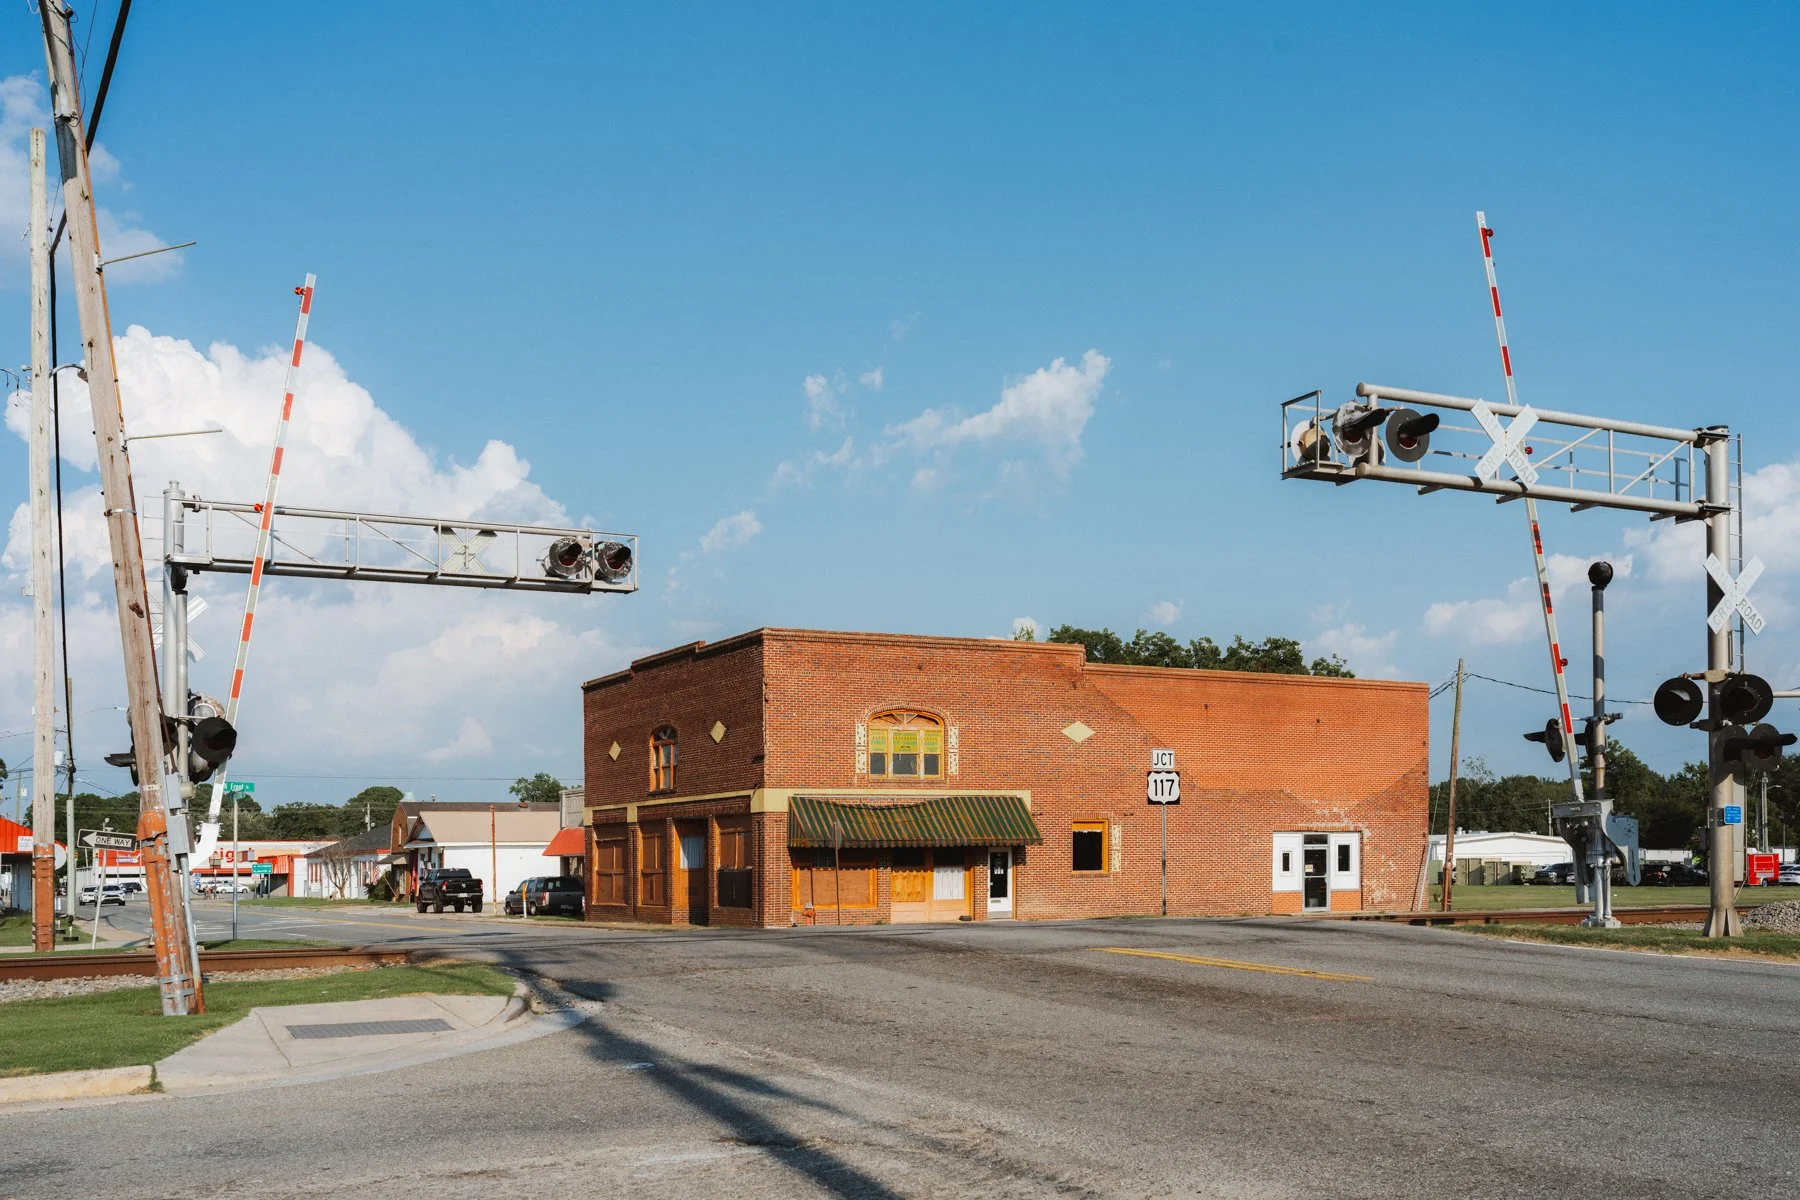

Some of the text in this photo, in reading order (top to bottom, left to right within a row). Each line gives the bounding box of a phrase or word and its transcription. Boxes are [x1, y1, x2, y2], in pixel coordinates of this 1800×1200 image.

[1508, 449, 1534, 483] ROAD
[1738, 598, 1762, 630] ROAD
[1153, 752, 1174, 766] JCT
[1153, 778, 1175, 797] 117
[95, 836, 131, 847] ONE WAY
